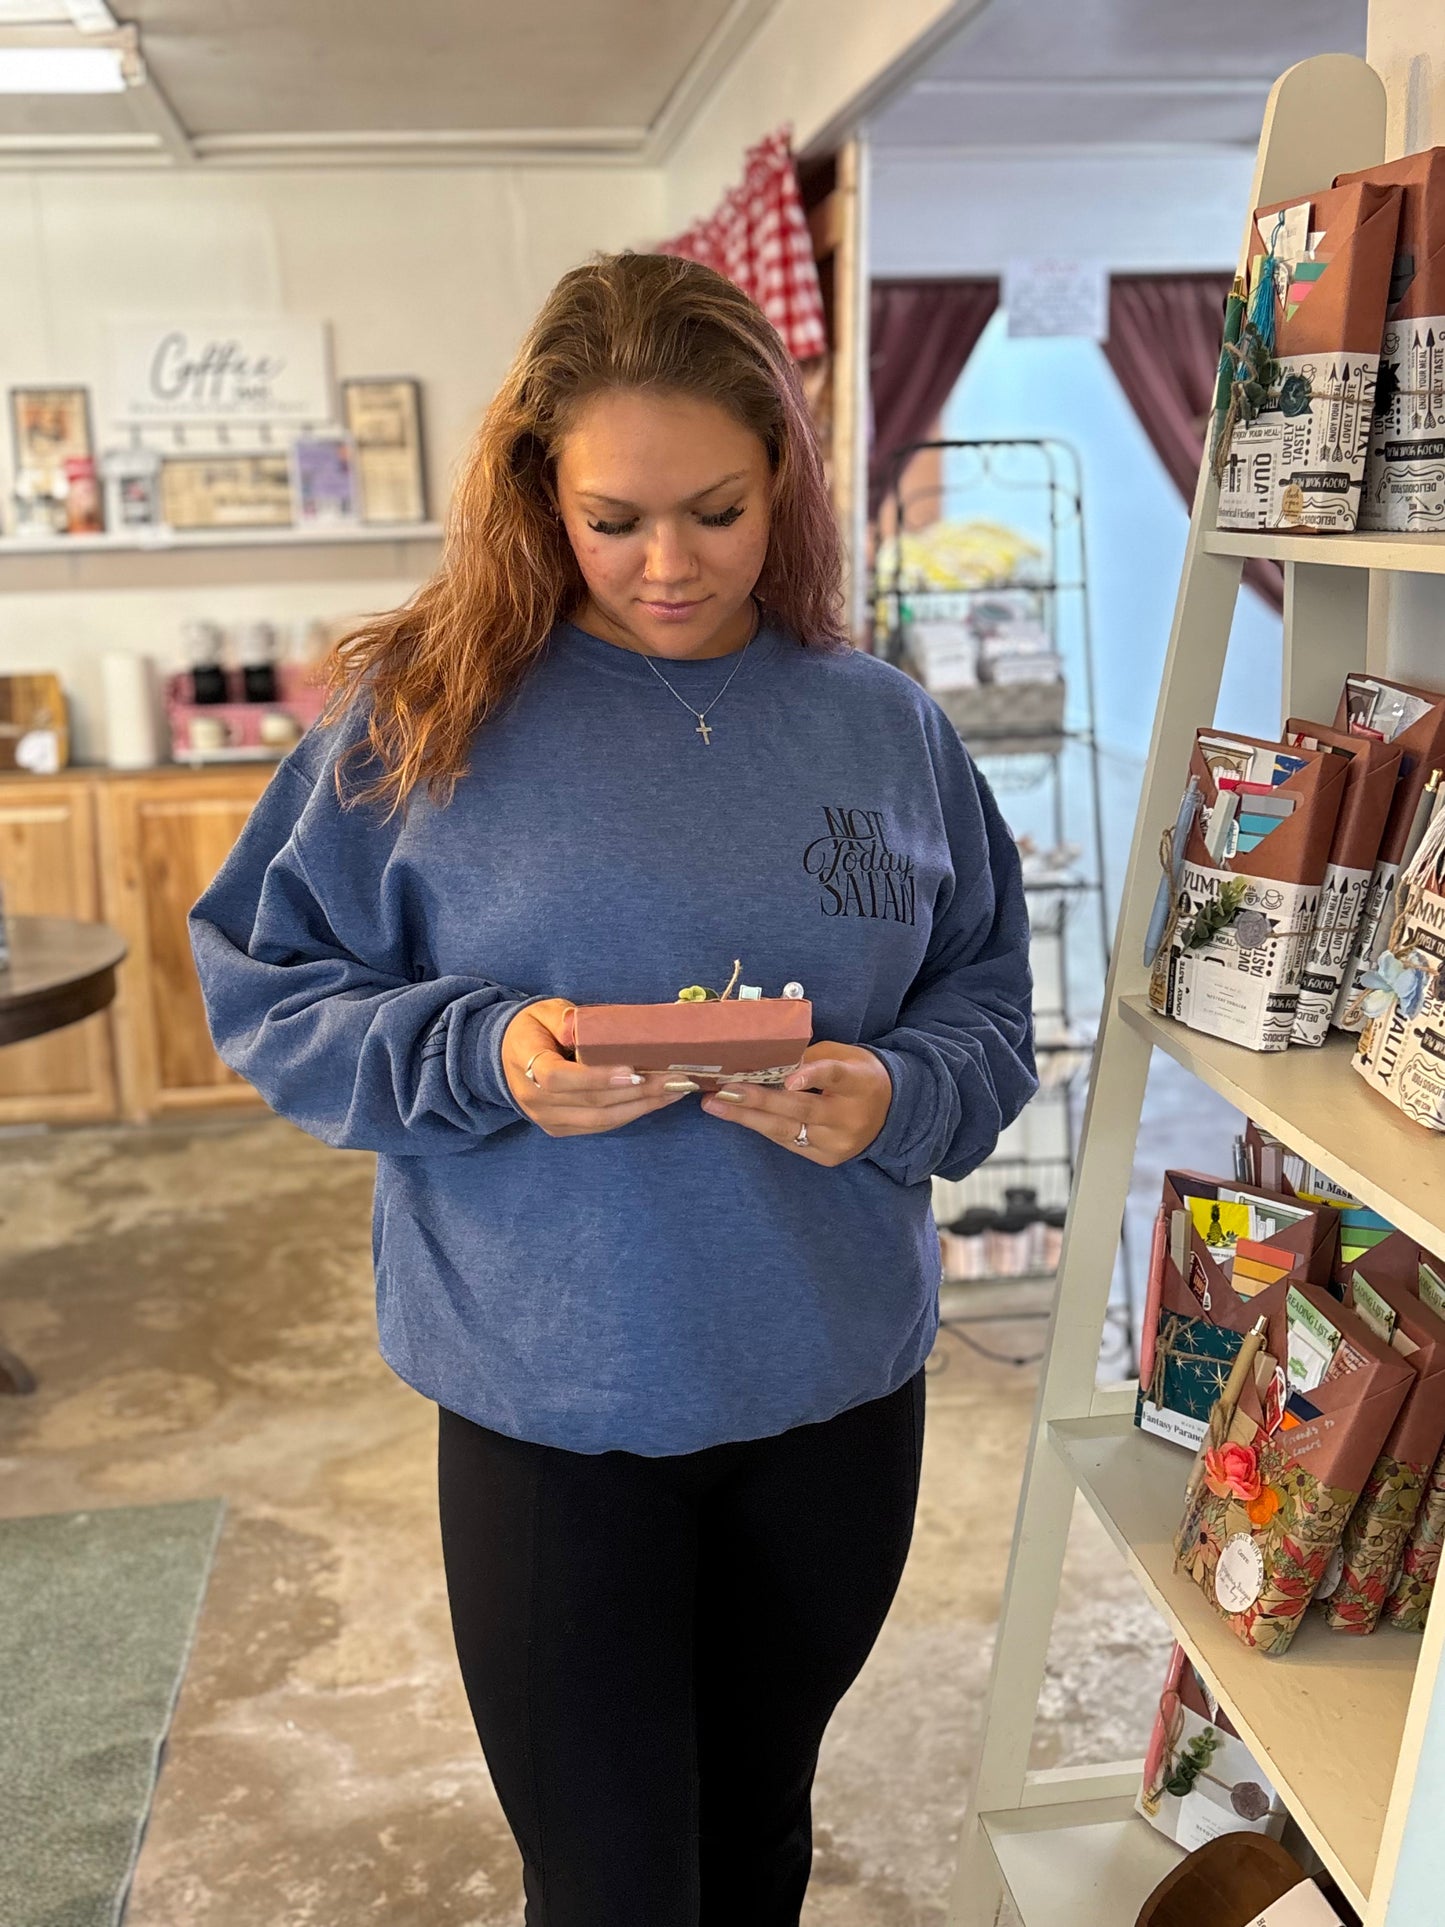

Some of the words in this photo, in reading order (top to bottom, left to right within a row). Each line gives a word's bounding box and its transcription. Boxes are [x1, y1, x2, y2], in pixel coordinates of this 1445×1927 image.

[150, 331, 287, 401] Coffee
[1434, 348, 1444, 376] TASTE
[1330, 402, 1340, 421] YOUR
[1281, 422, 1295, 465] LOVELY
[1292, 423, 1307, 462] TASTE
[1328, 422, 1338, 443] ENJOY
[1342, 413, 1353, 444] LOVELY
[821, 806, 889, 854] NOT
[803, 835, 914, 886] Today
[818, 867, 915, 926] SATAN
[1329, 894, 1339, 911] MEAL
[1341, 896, 1354, 921] TASTE
[1177, 960, 1186, 985] TASTE
[1307, 978, 1335, 991] ENJOY
[1175, 987, 1184, 1017] LOVELY
[1287, 1293, 1314, 1325] READING
[1313, 1319, 1329, 1339] LIST
